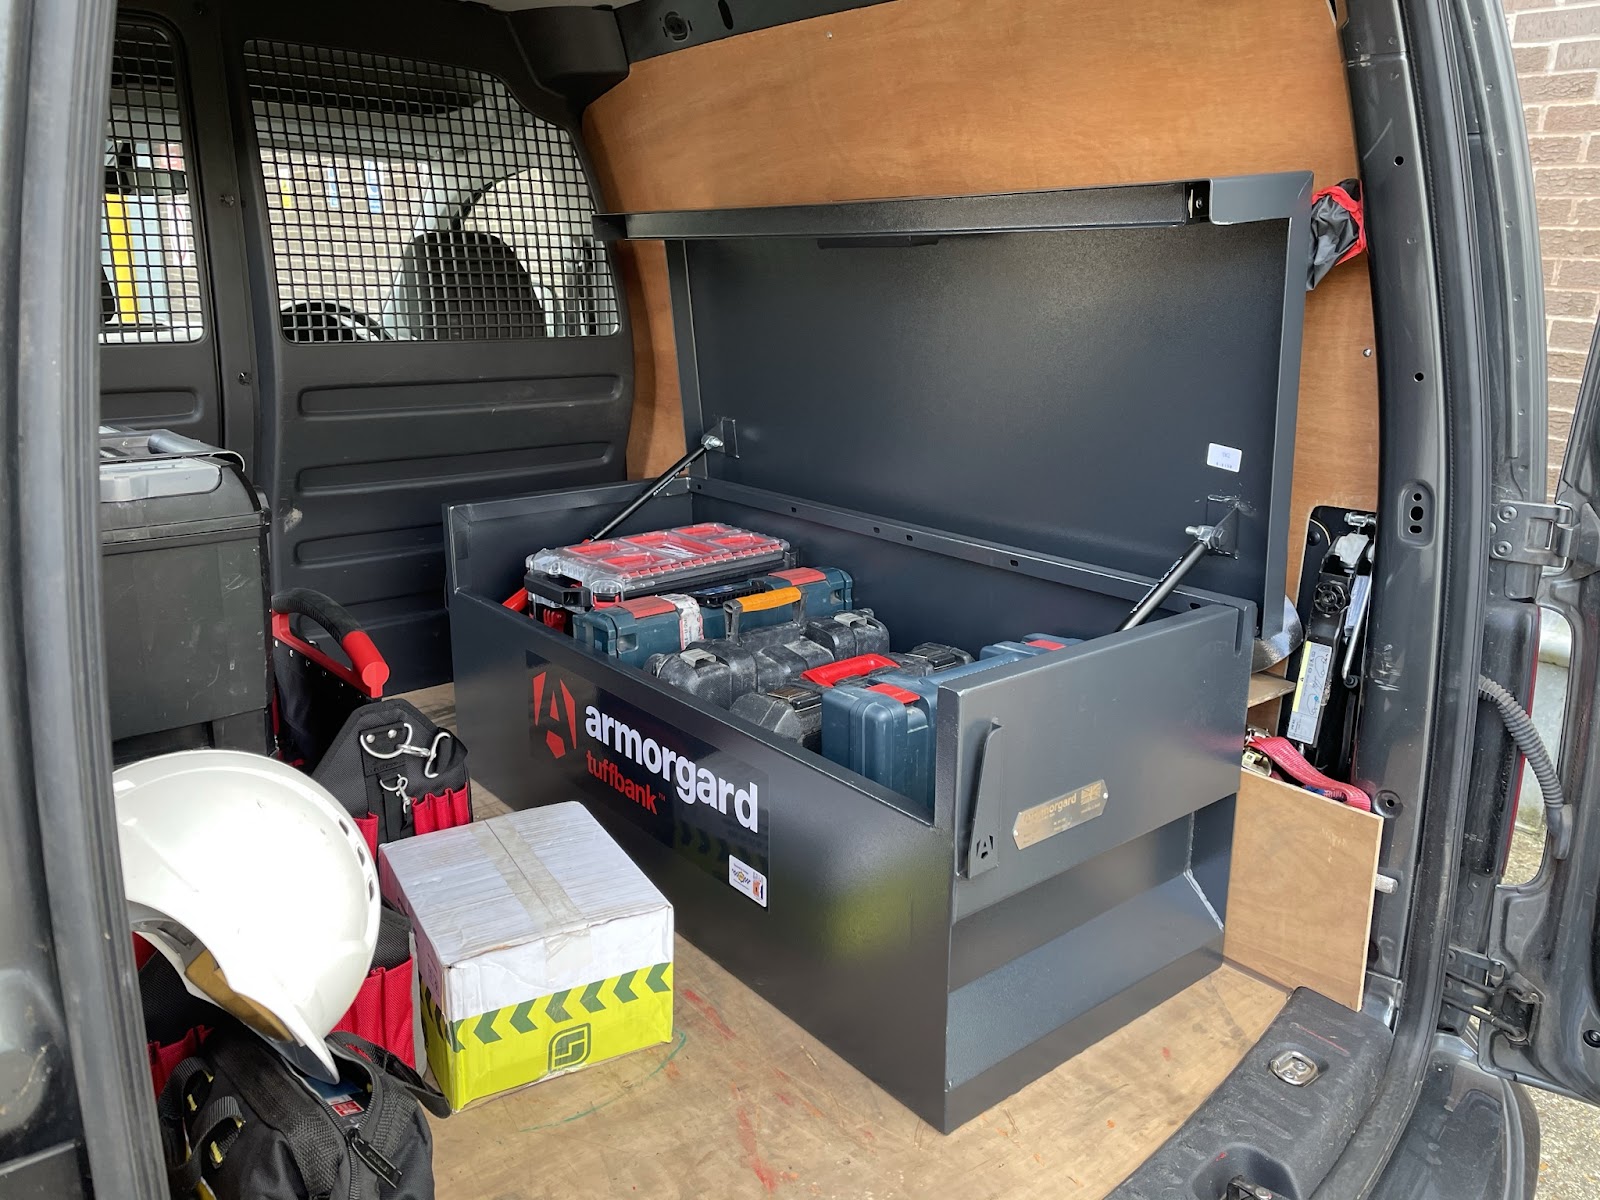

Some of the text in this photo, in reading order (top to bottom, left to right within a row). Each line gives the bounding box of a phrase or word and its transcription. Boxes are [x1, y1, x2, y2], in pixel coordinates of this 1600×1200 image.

[584, 705, 758, 833] armorgard
[586, 750, 658, 815] tuffbank
[1030, 793, 1077, 819] amorgard
